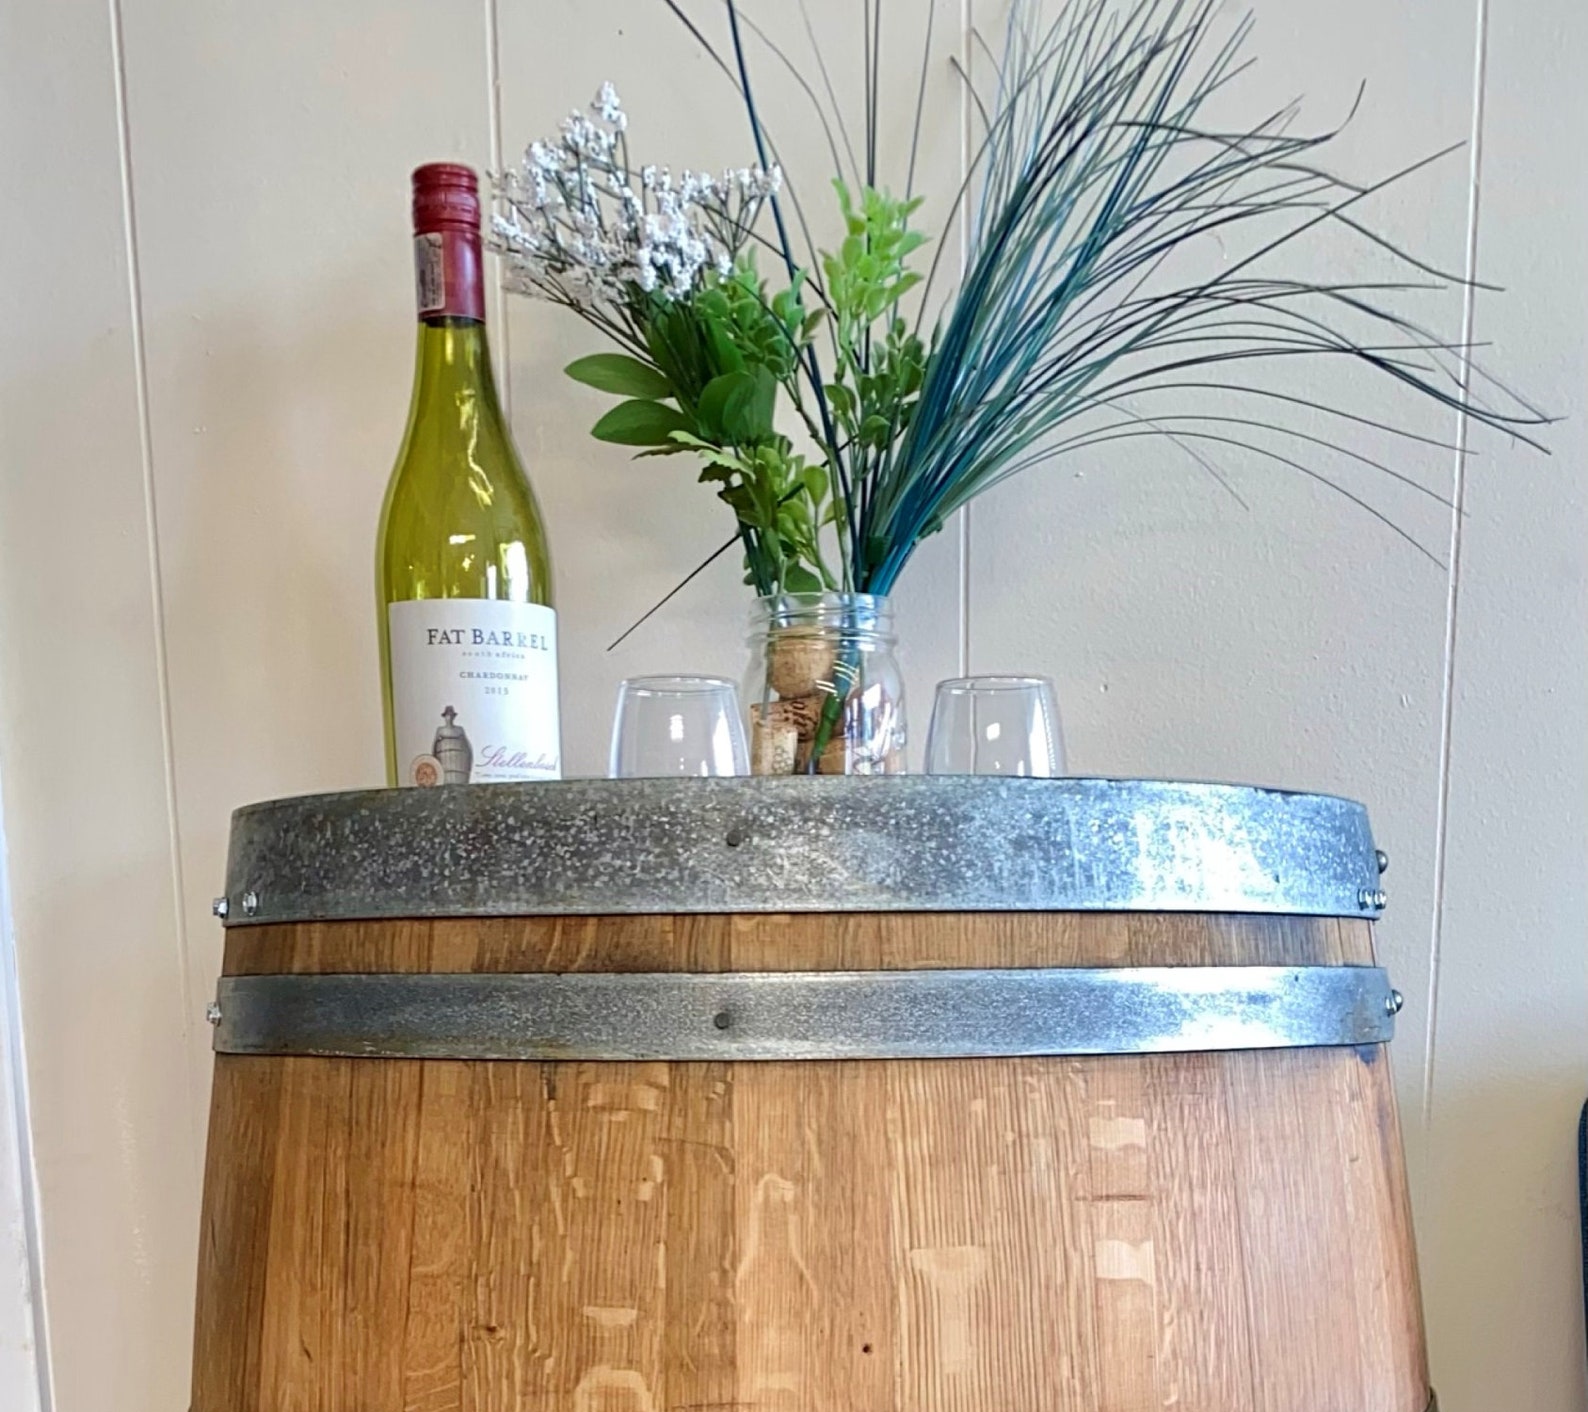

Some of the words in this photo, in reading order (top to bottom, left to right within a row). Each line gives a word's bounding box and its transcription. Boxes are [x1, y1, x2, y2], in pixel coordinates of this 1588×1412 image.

[427, 629, 465, 645] FAT
[472, 629, 548, 651] BARREL
[459, 671, 528, 681] CHARDONNAY
